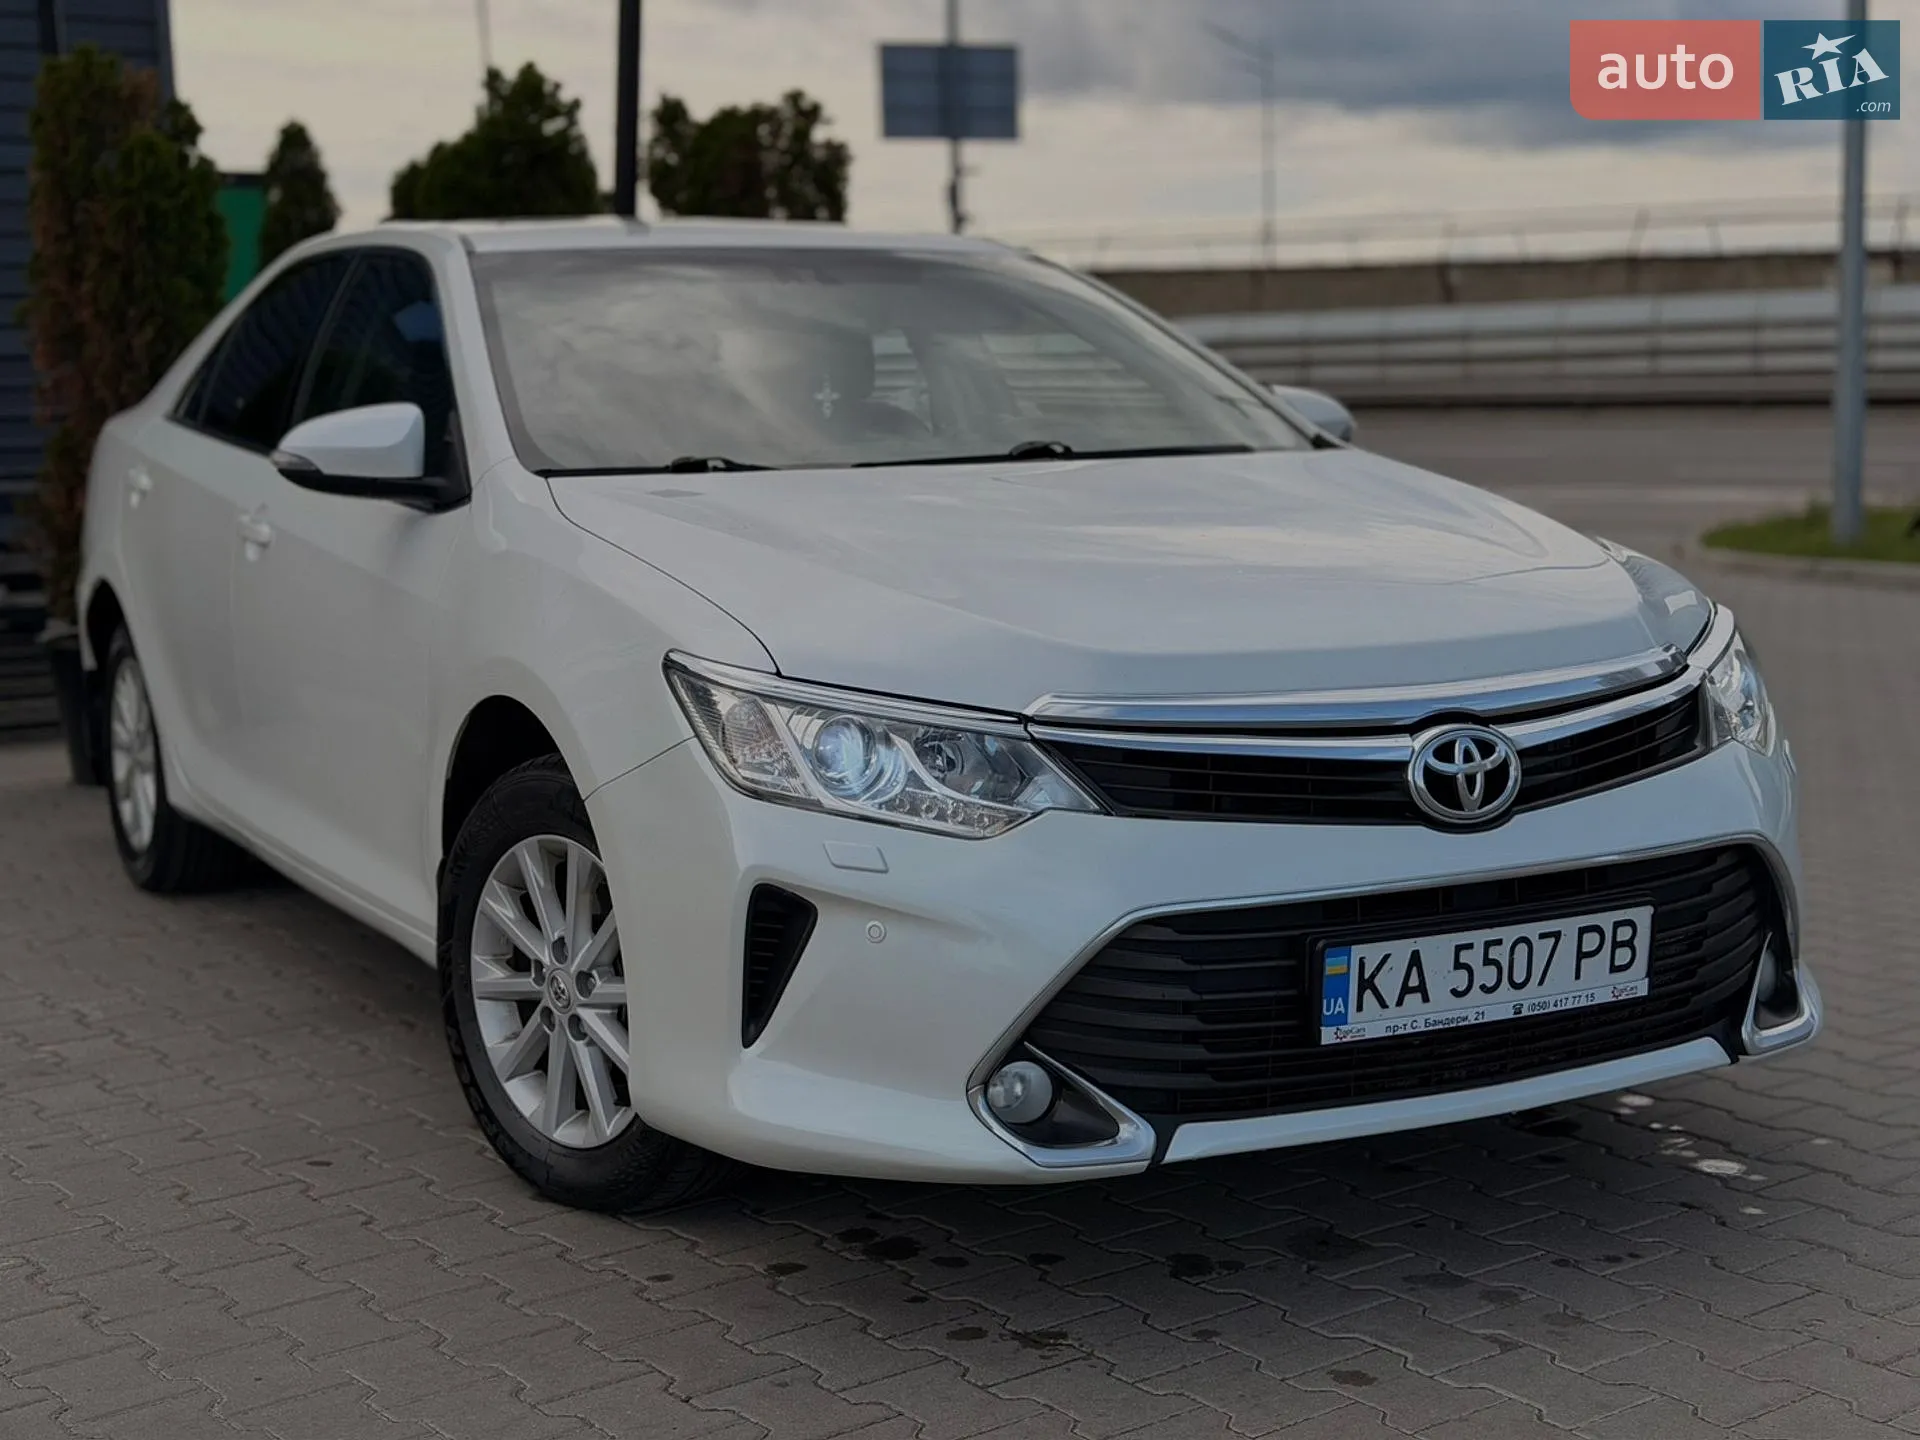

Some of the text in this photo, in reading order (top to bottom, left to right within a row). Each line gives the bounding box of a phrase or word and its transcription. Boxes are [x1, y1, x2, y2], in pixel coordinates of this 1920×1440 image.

[1355, 918, 1638, 1013] KA 5507 PB
[1322, 997, 1345, 1016] UA
[1527, 992, 1596, 1013] (050) 417 77 15
[1474, 1010, 1485, 1021] 21
